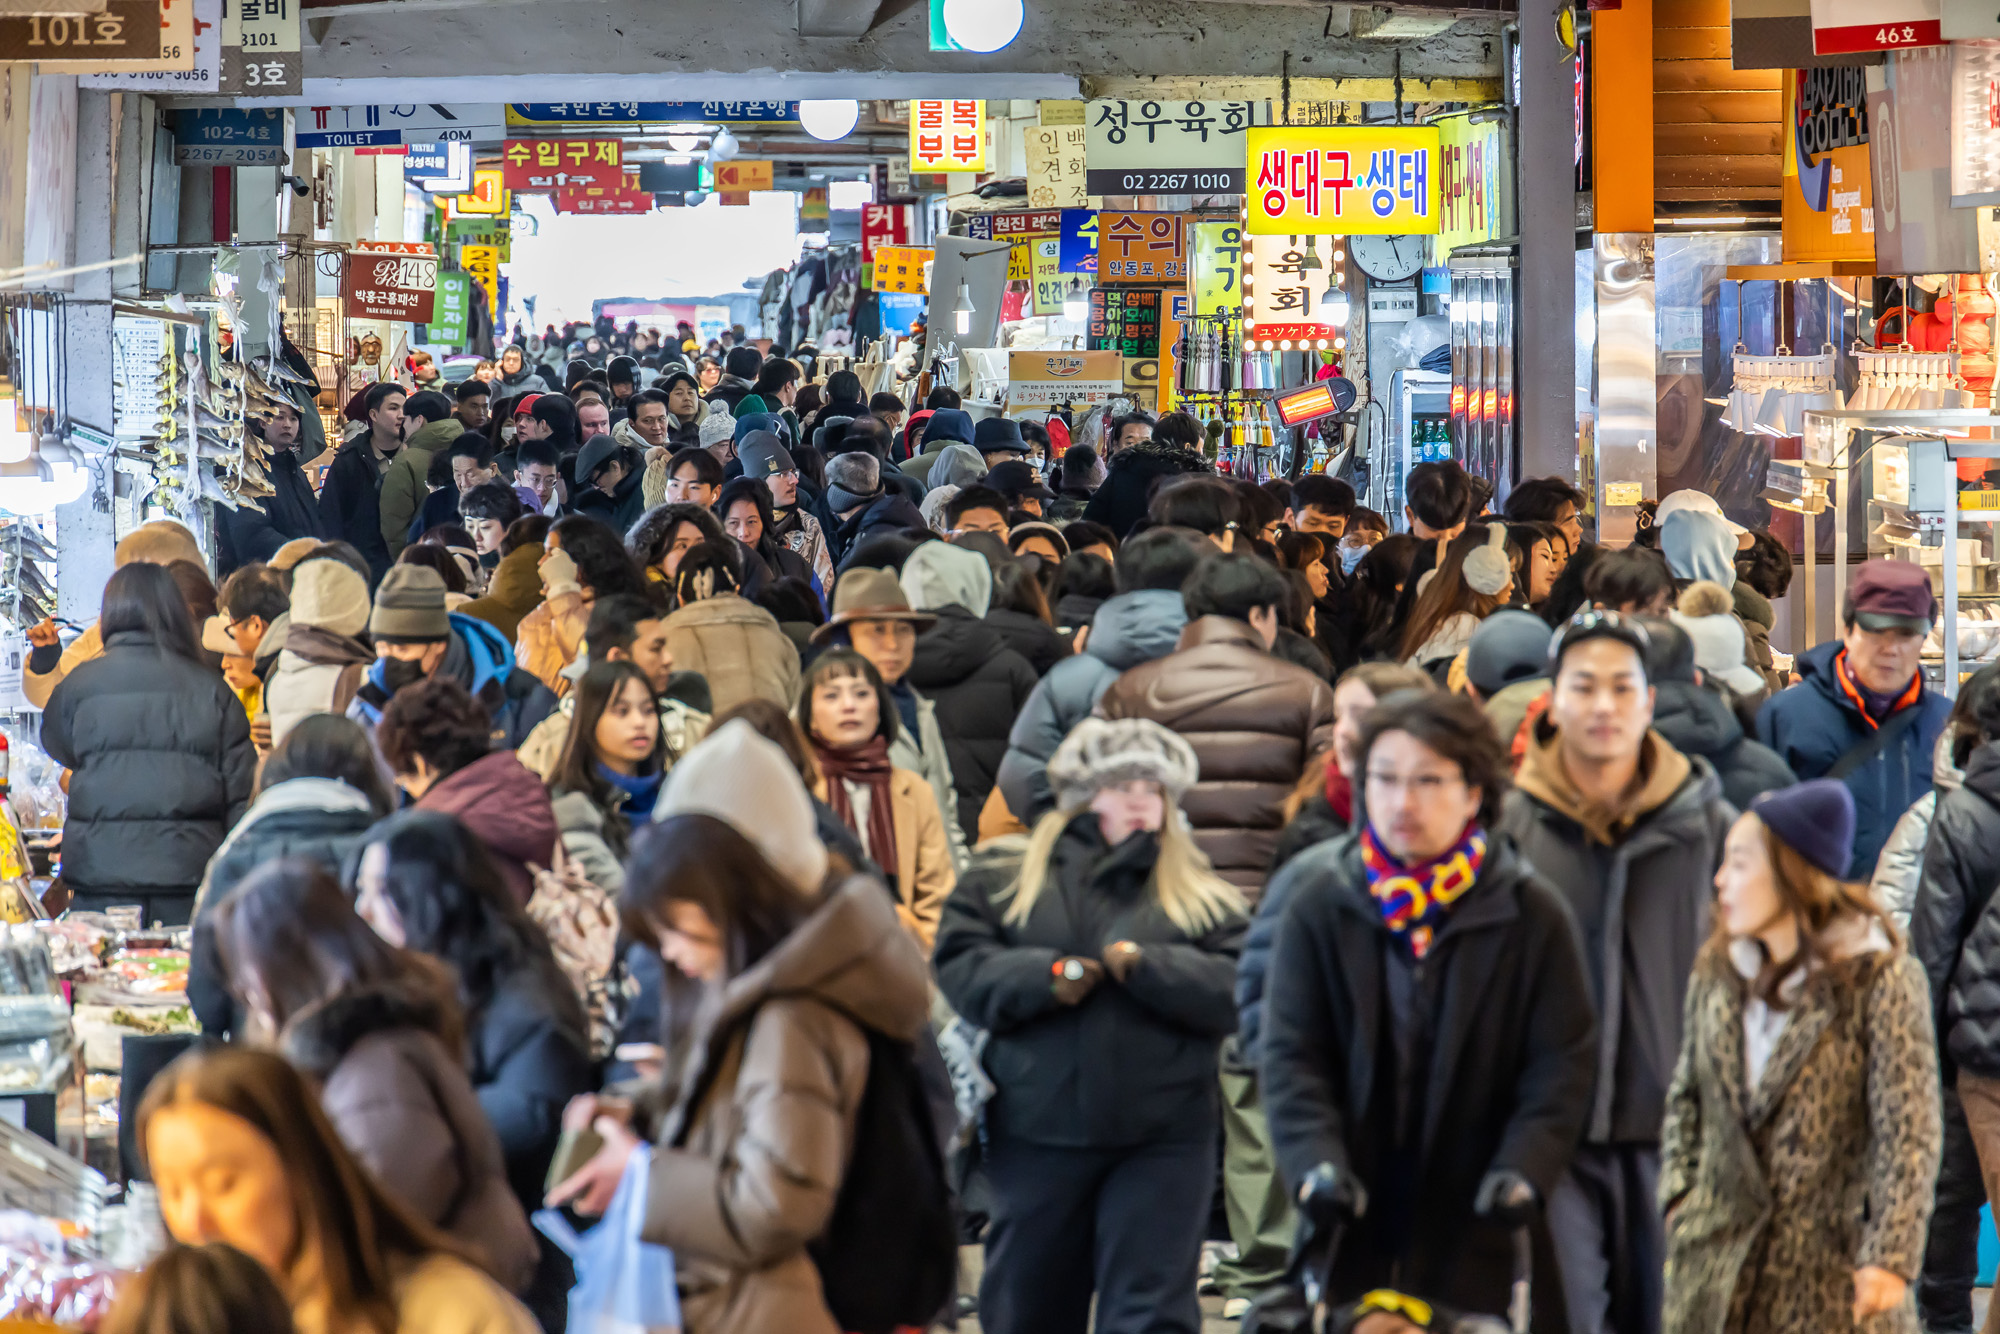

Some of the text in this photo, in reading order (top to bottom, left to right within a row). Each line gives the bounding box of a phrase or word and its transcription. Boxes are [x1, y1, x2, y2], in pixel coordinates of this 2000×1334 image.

[28, 16, 126, 46] 101호
[1875, 26, 1917, 44] 46호
[1094, 100, 1254, 145] 성우육회
[202, 126, 271, 140] 102-4호
[325, 134, 373, 145] TOILET
[438, 130, 472, 141] 40M
[181, 148, 277, 161] 2267-2054
[507, 141, 619, 167] 수입구제
[1123, 174, 1230, 189] 02 2267 1010
[994, 216, 1026, 231] 원진
[1107, 214, 1182, 258] 수의
[400, 261, 436, 288] 148
[355, 289, 419, 306] 박홍근홈패션
